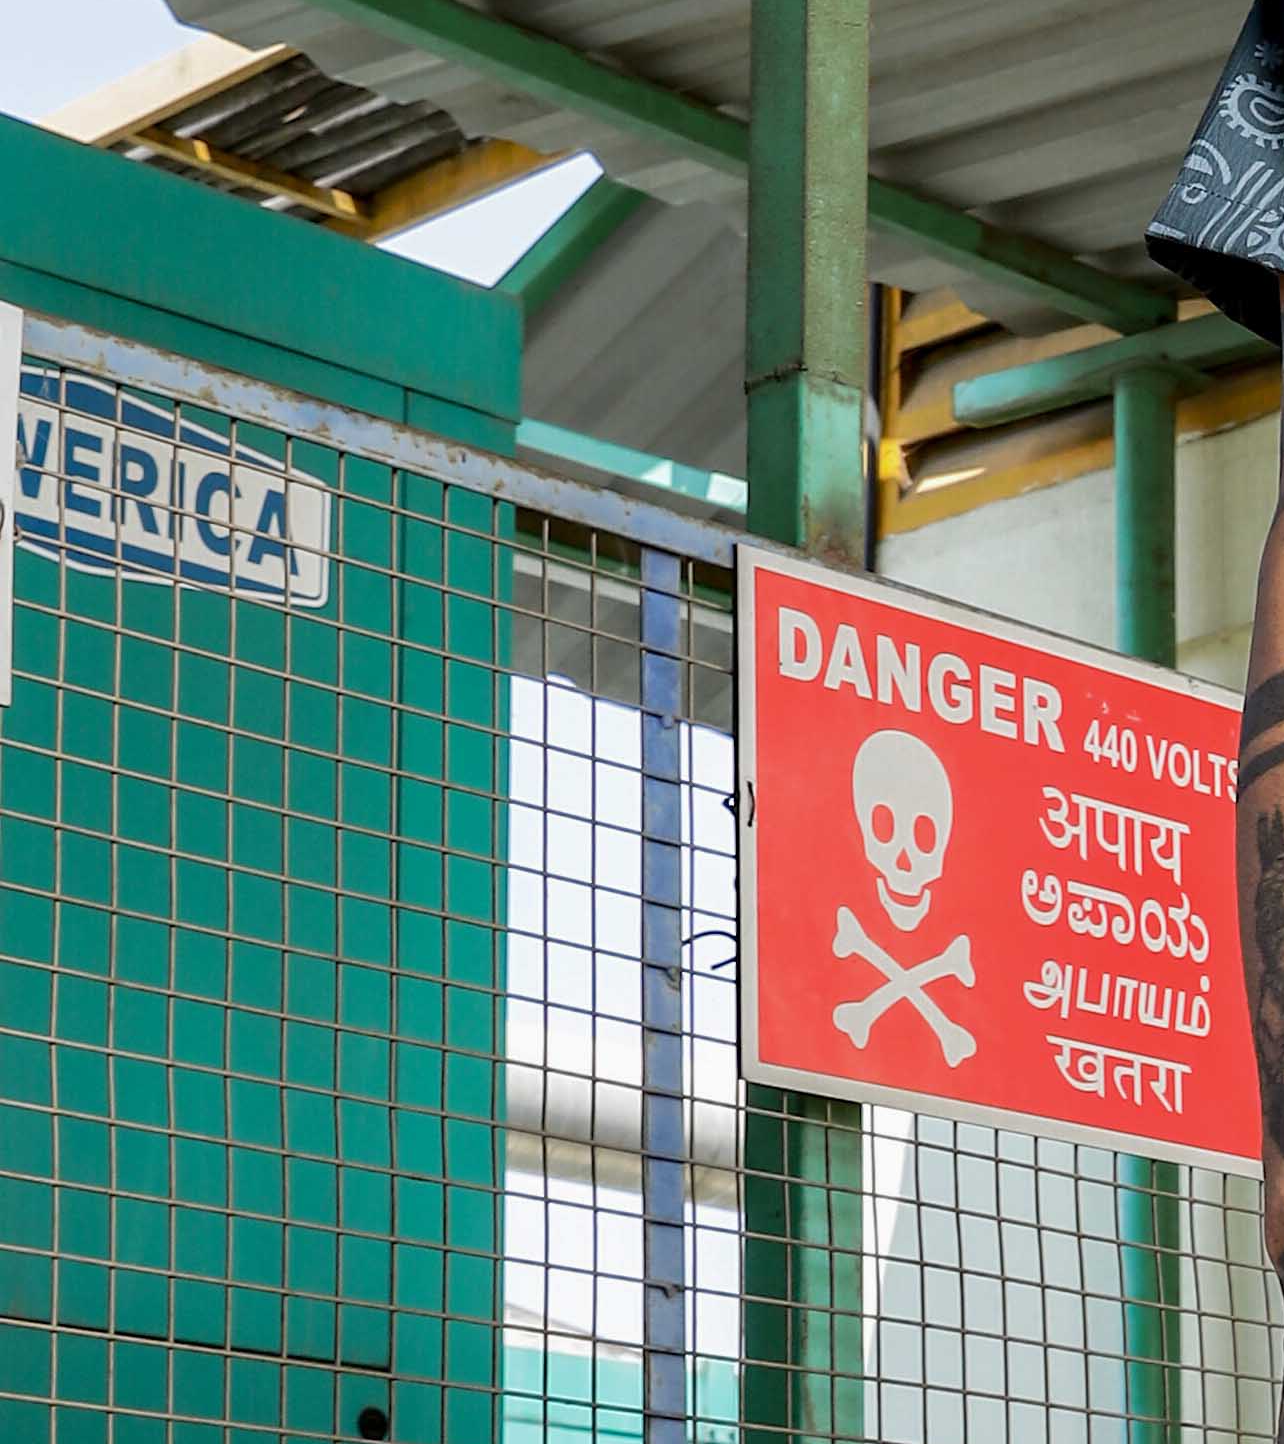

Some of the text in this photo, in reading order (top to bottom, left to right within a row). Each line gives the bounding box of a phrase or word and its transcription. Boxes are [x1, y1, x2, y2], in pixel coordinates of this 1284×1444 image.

[777, 606, 1239, 803] DANGER 440 VOLTS
[1038, 785, 1189, 885] अपाय
[1021, 868, 1210, 964] ಅಪಾಯ
[1022, 959, 1211, 1037] அபாயம்
[1045, 1034, 1192, 1115] खतरा
